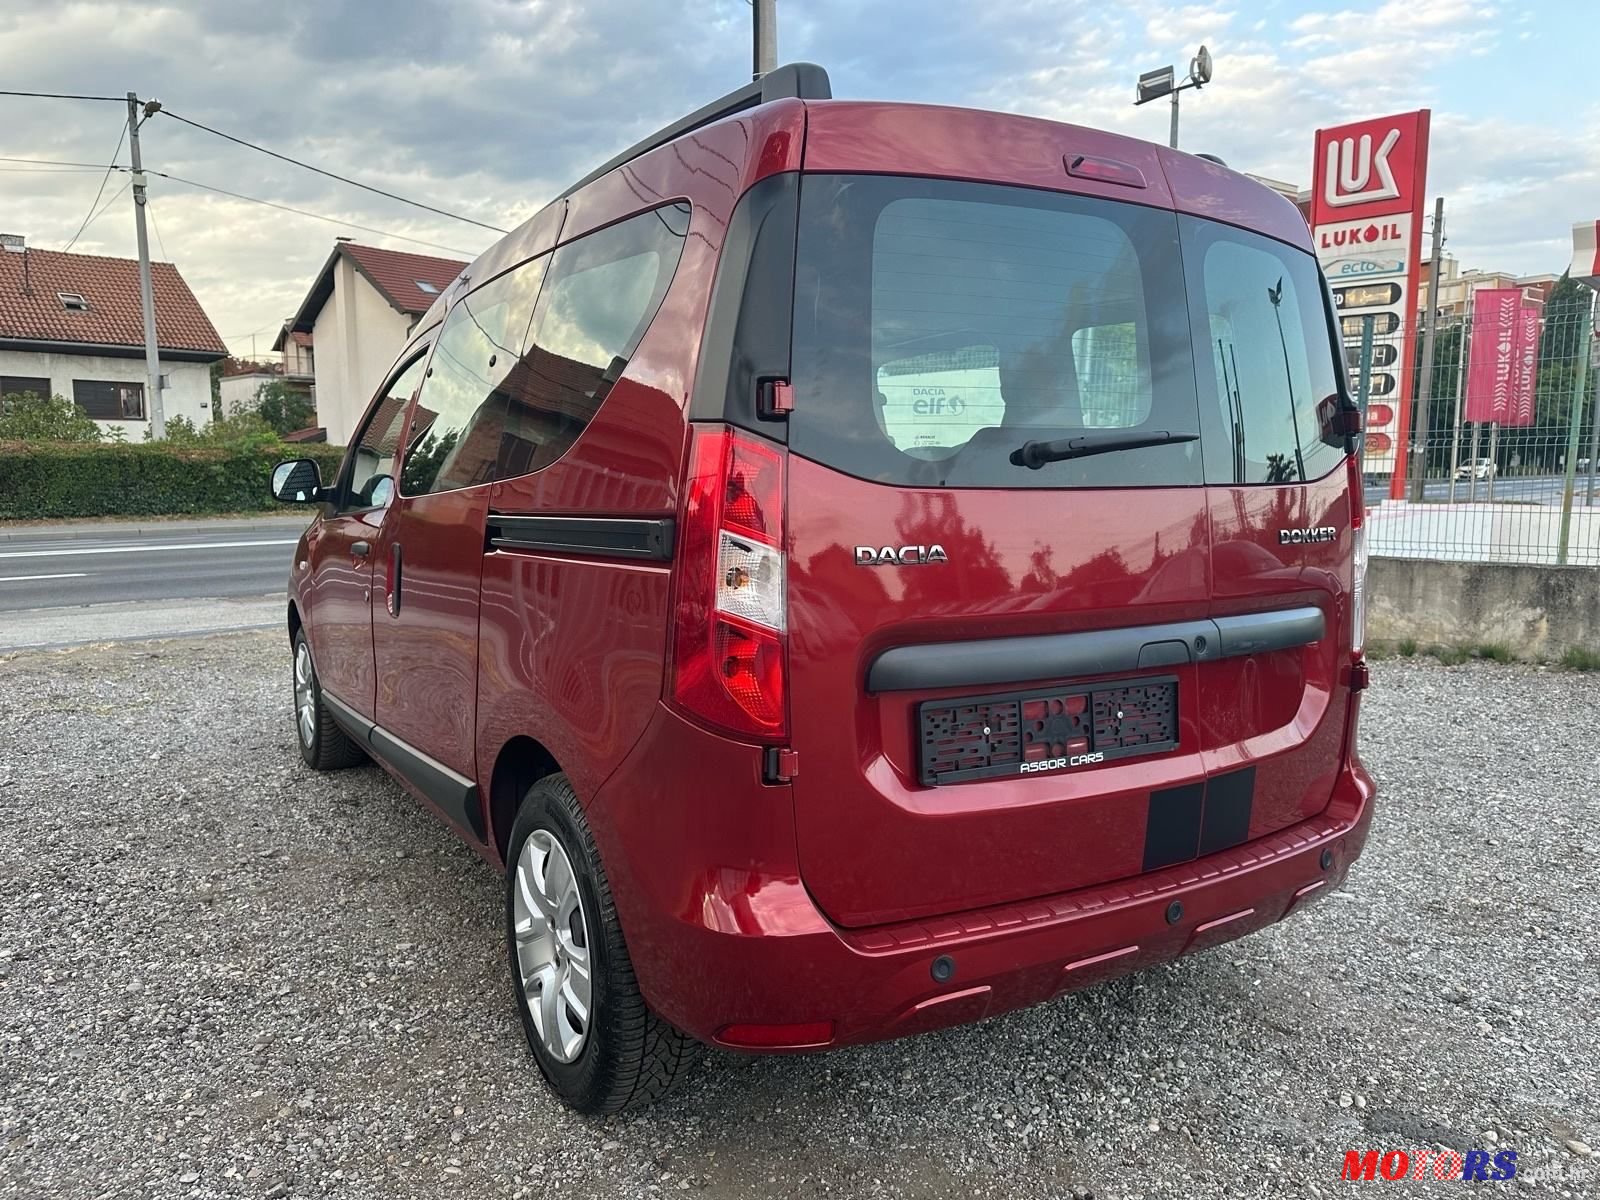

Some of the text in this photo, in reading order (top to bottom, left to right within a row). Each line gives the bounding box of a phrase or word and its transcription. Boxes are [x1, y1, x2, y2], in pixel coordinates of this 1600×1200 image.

[1321, 223, 1402, 249] LUKOIL
[1341, 259, 1377, 274] ecto
[1496, 329, 1512, 380] LUKOIL
[1521, 344, 1535, 390] LUKOIL
[913, 388, 946, 396] DACIA
[913, 398, 946, 415] elf
[1279, 526, 1337, 545] DOKKER
[854, 544, 949, 565] DACIA
[1020, 751, 1105, 774] ASGOR CARS
